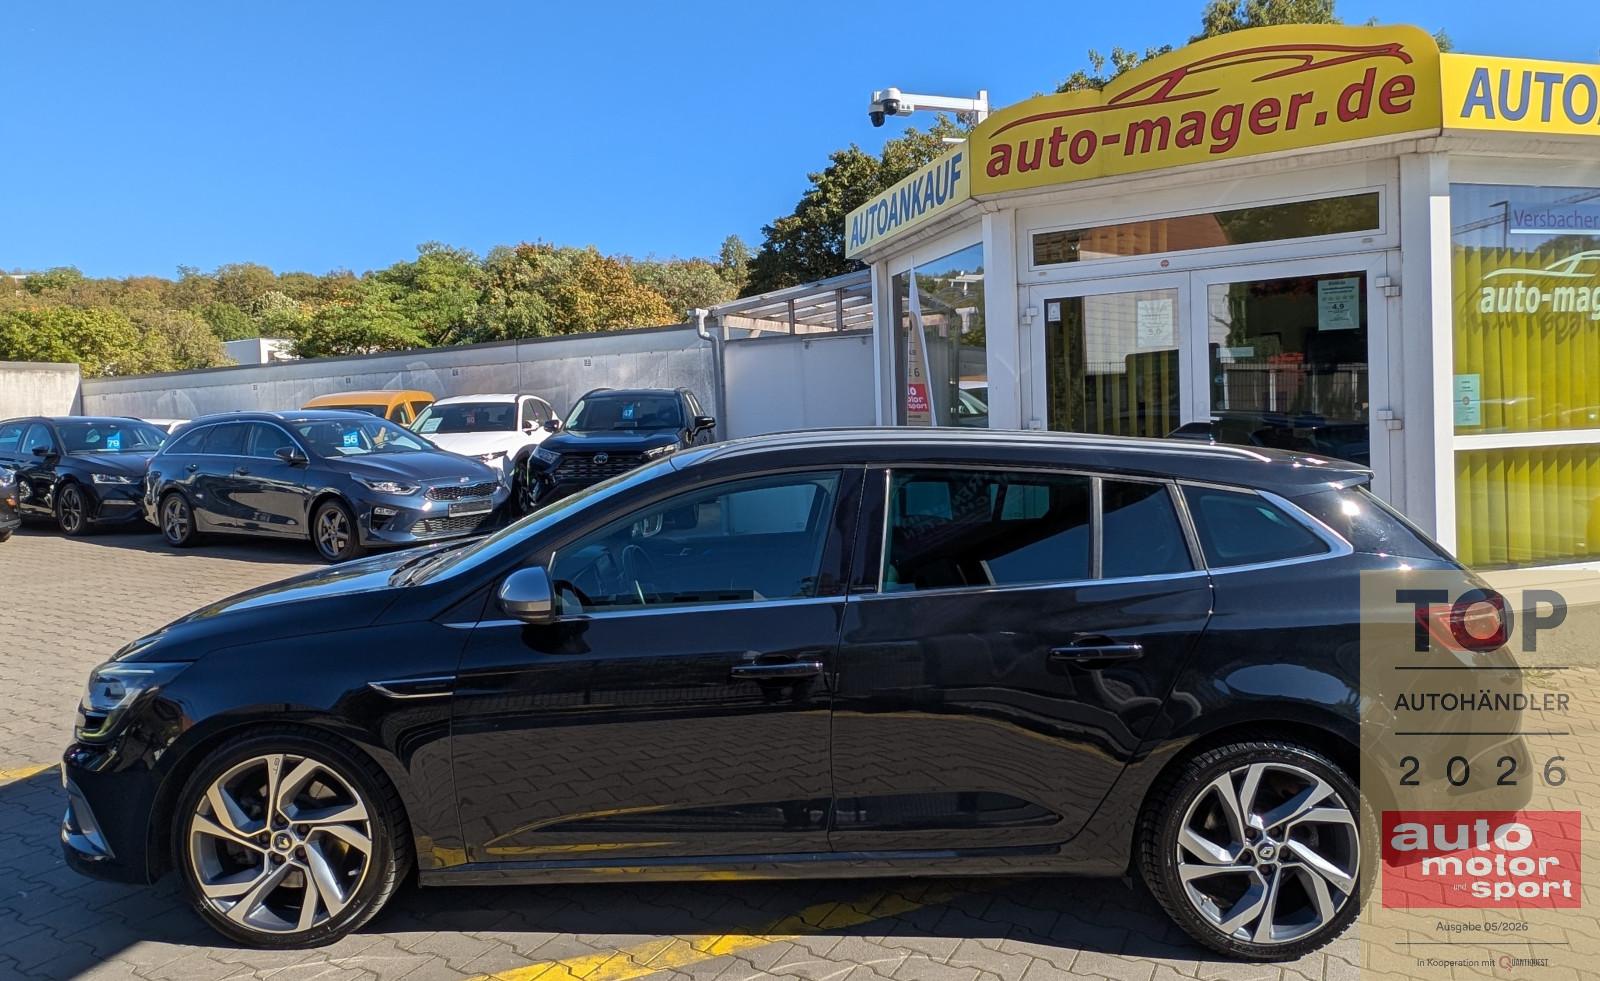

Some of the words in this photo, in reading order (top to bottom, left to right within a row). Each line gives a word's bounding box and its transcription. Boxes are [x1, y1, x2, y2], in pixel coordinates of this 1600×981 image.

[986, 67, 1416, 178] auto-mager.de
[1460, 67, 1600, 125] AUTO
[849, 151, 963, 250] AUTOANKAUF
[107, 439, 120, 448] 79
[343, 434, 358, 444] 56
